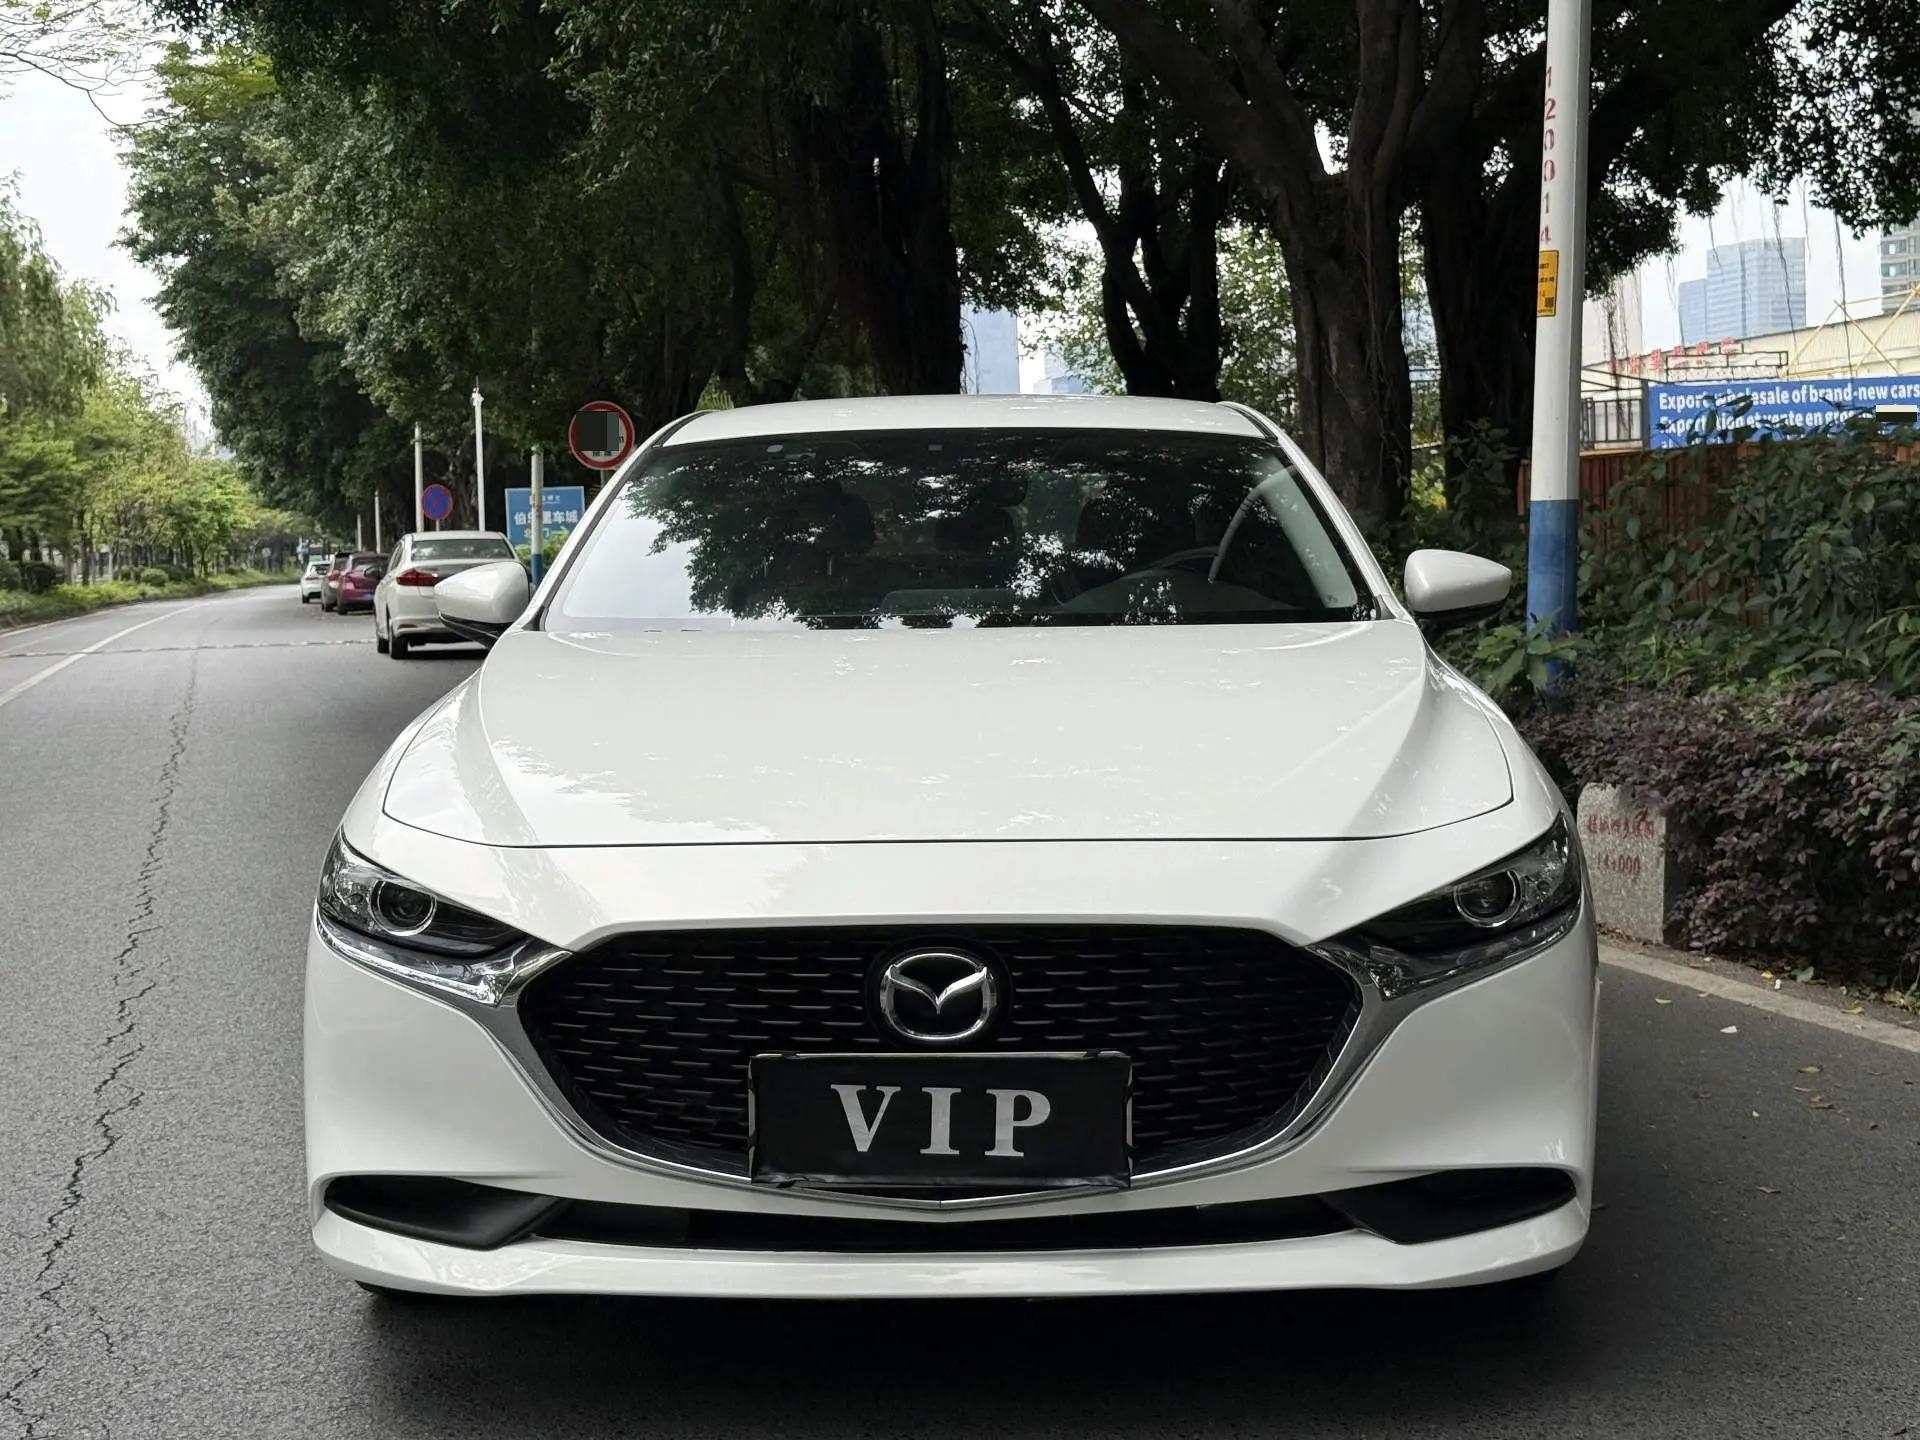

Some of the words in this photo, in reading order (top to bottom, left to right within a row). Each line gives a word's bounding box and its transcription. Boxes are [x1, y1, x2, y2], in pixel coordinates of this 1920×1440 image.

[1659, 391, 1711, 413] Export
[1791, 384, 1807, 402] of
[1809, 382, 1888, 402] brand-new
[1890, 383, 1920, 400] cars
[1659, 412, 1745, 436] Exporttion
[1805, 411, 1822, 427] en
[830, 1084, 1051, 1157] VIP
